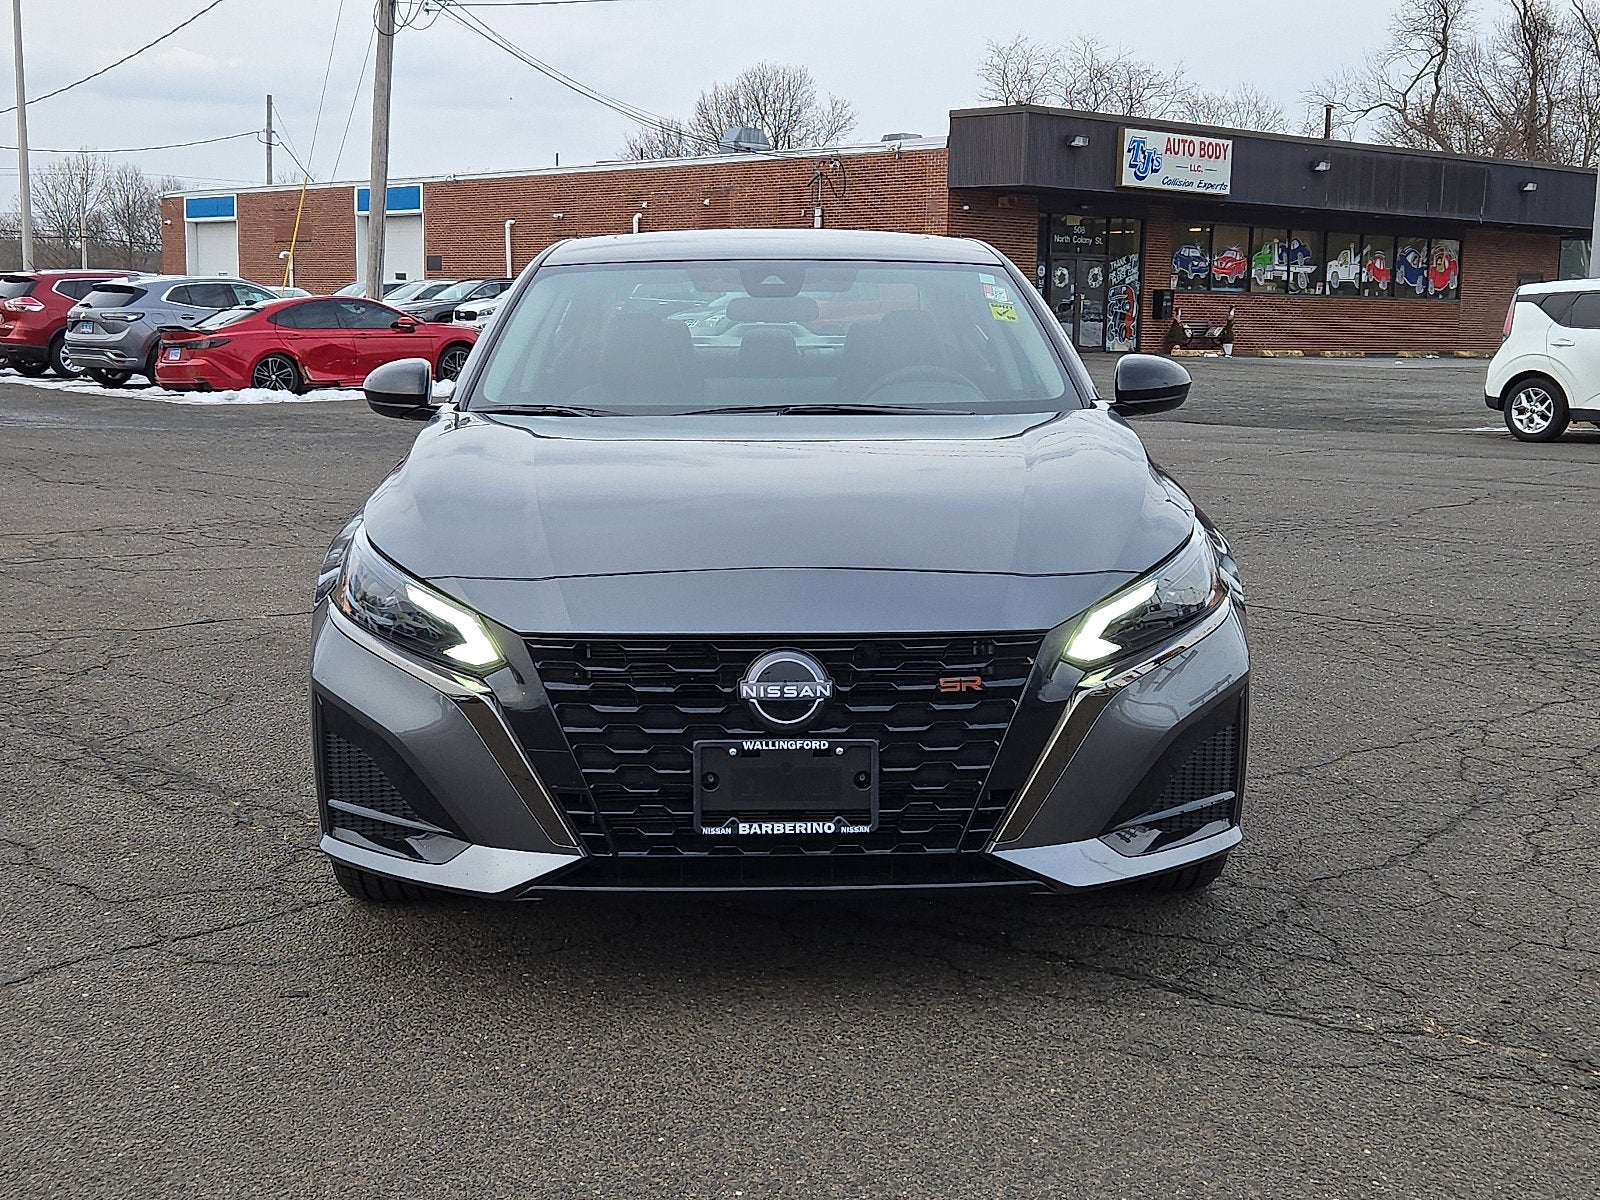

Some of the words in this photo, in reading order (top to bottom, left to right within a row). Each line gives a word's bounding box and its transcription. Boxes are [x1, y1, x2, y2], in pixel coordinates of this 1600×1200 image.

[1164, 137, 1196, 157] AUTO
[1199, 141, 1230, 160] BODY
[1189, 164, 1203, 173] LLC.
[1162, 176, 1194, 188] Collision
[1197, 180, 1228, 191] Experts
[1054, 234, 1071, 243] North
[1072, 235, 1093, 246] Colony
[939, 676, 982, 692] SR
[742, 684, 831, 698] NISSAN
[742, 740, 829, 750] WALLINGFORD
[702, 827, 732, 835] NISSAN
[738, 822, 835, 835] BARBERINO
[841, 826, 870, 834] NISSAN
